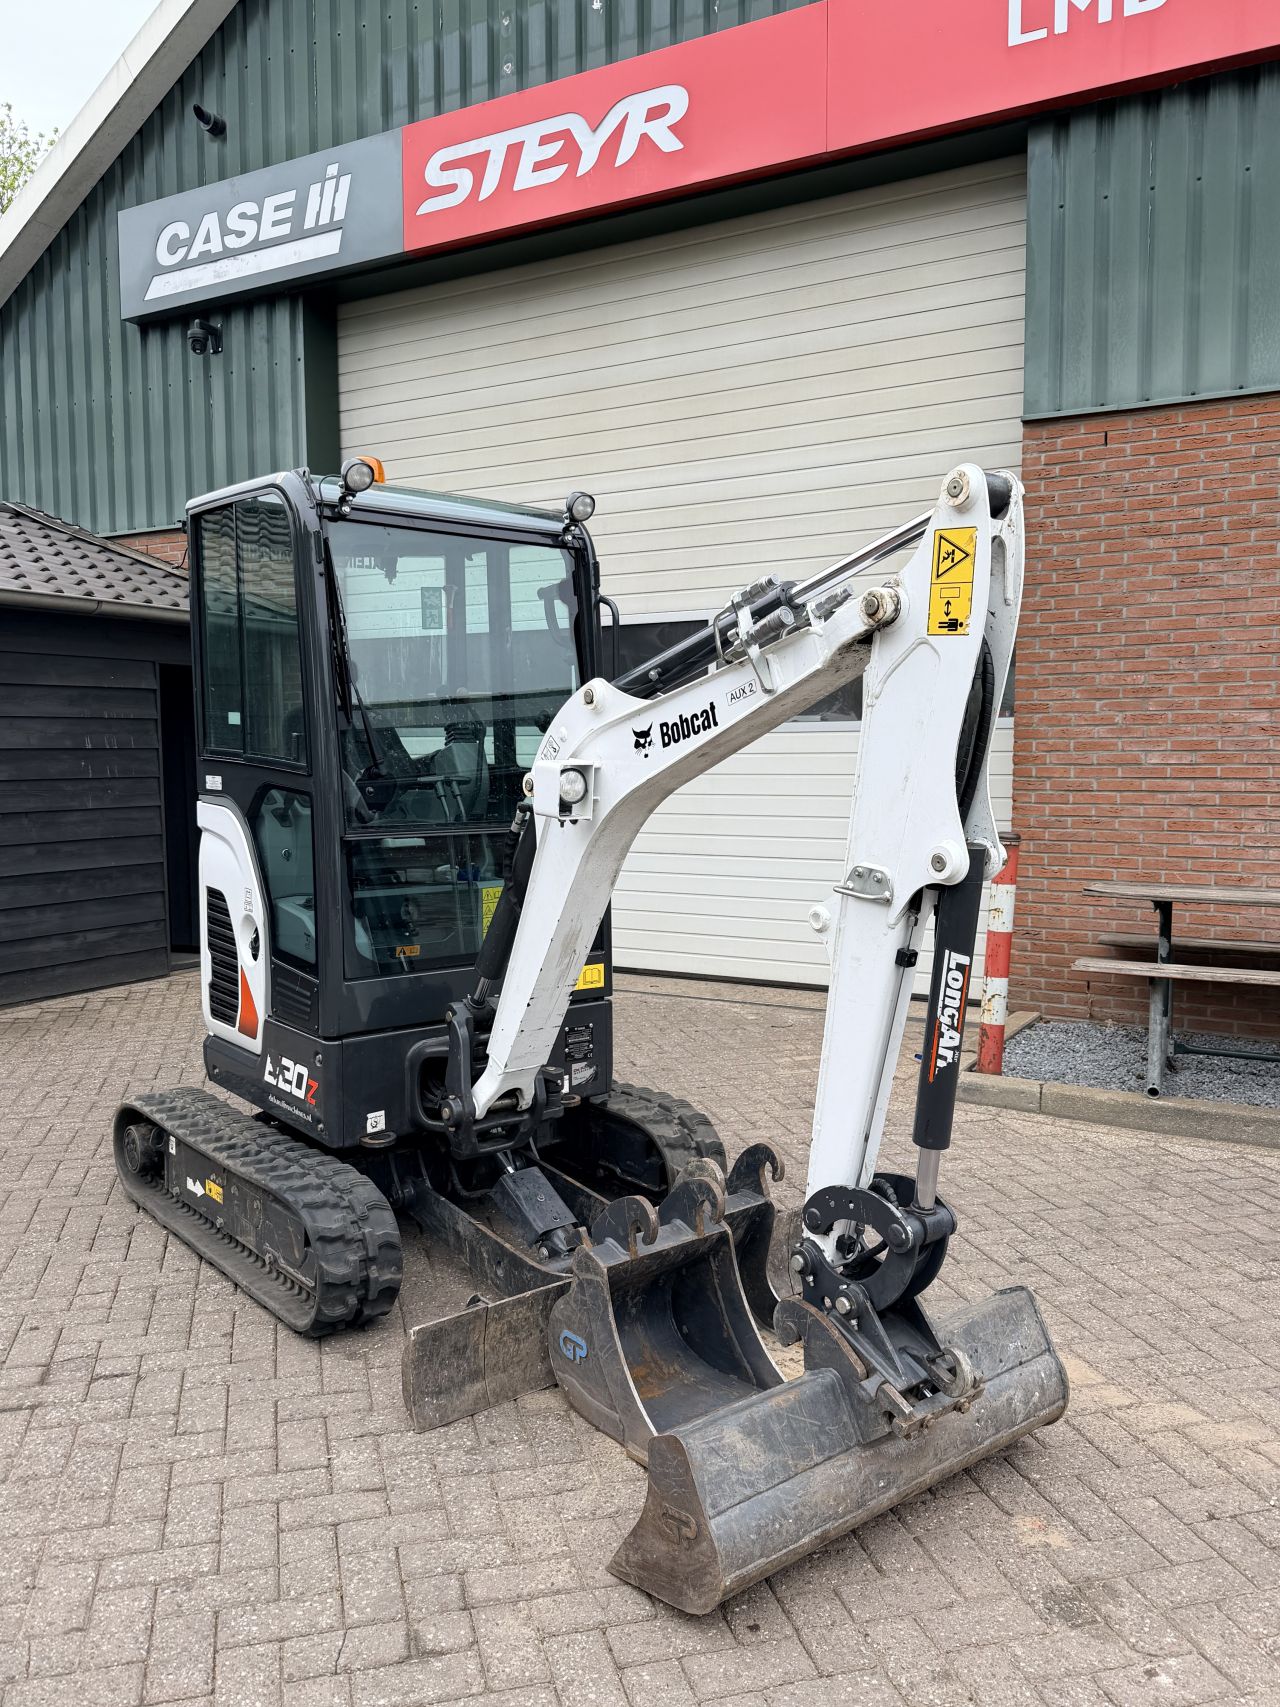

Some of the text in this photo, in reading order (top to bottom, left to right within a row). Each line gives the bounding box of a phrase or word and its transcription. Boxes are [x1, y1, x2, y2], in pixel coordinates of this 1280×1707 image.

[415, 83, 690, 216] STEYR
[155, 189, 297, 267] CASE
[659, 701, 719, 749] Bobcat
[730, 682, 755, 703] AUX 2
[936, 951, 970, 1075] LongAr
